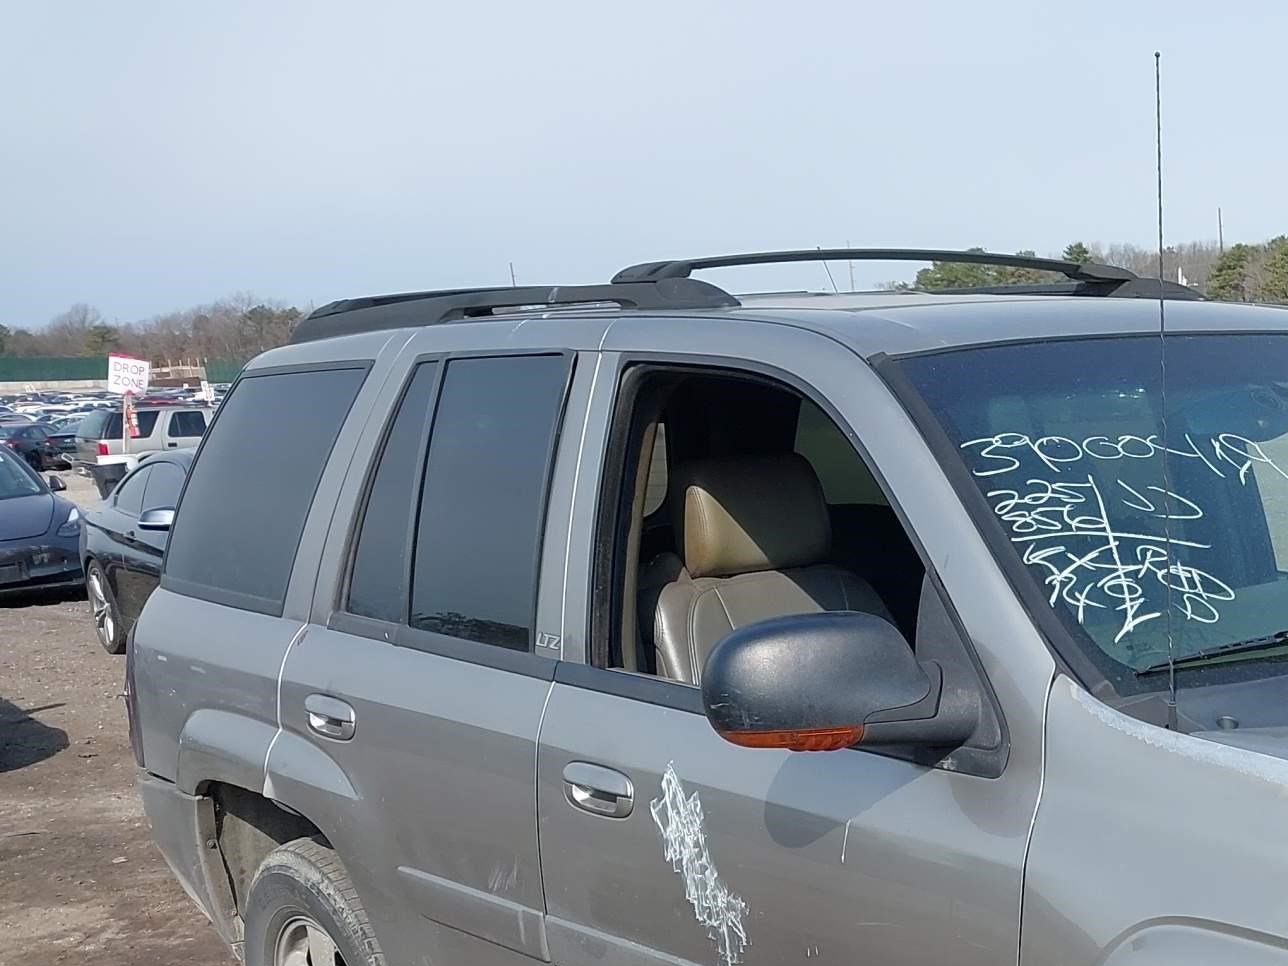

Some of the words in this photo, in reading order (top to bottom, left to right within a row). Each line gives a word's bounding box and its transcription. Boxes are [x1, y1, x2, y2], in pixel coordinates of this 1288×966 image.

[113, 361, 145, 376] DROP
[113, 375, 145, 389] ZONE
[535, 632, 561, 650] LTZ
